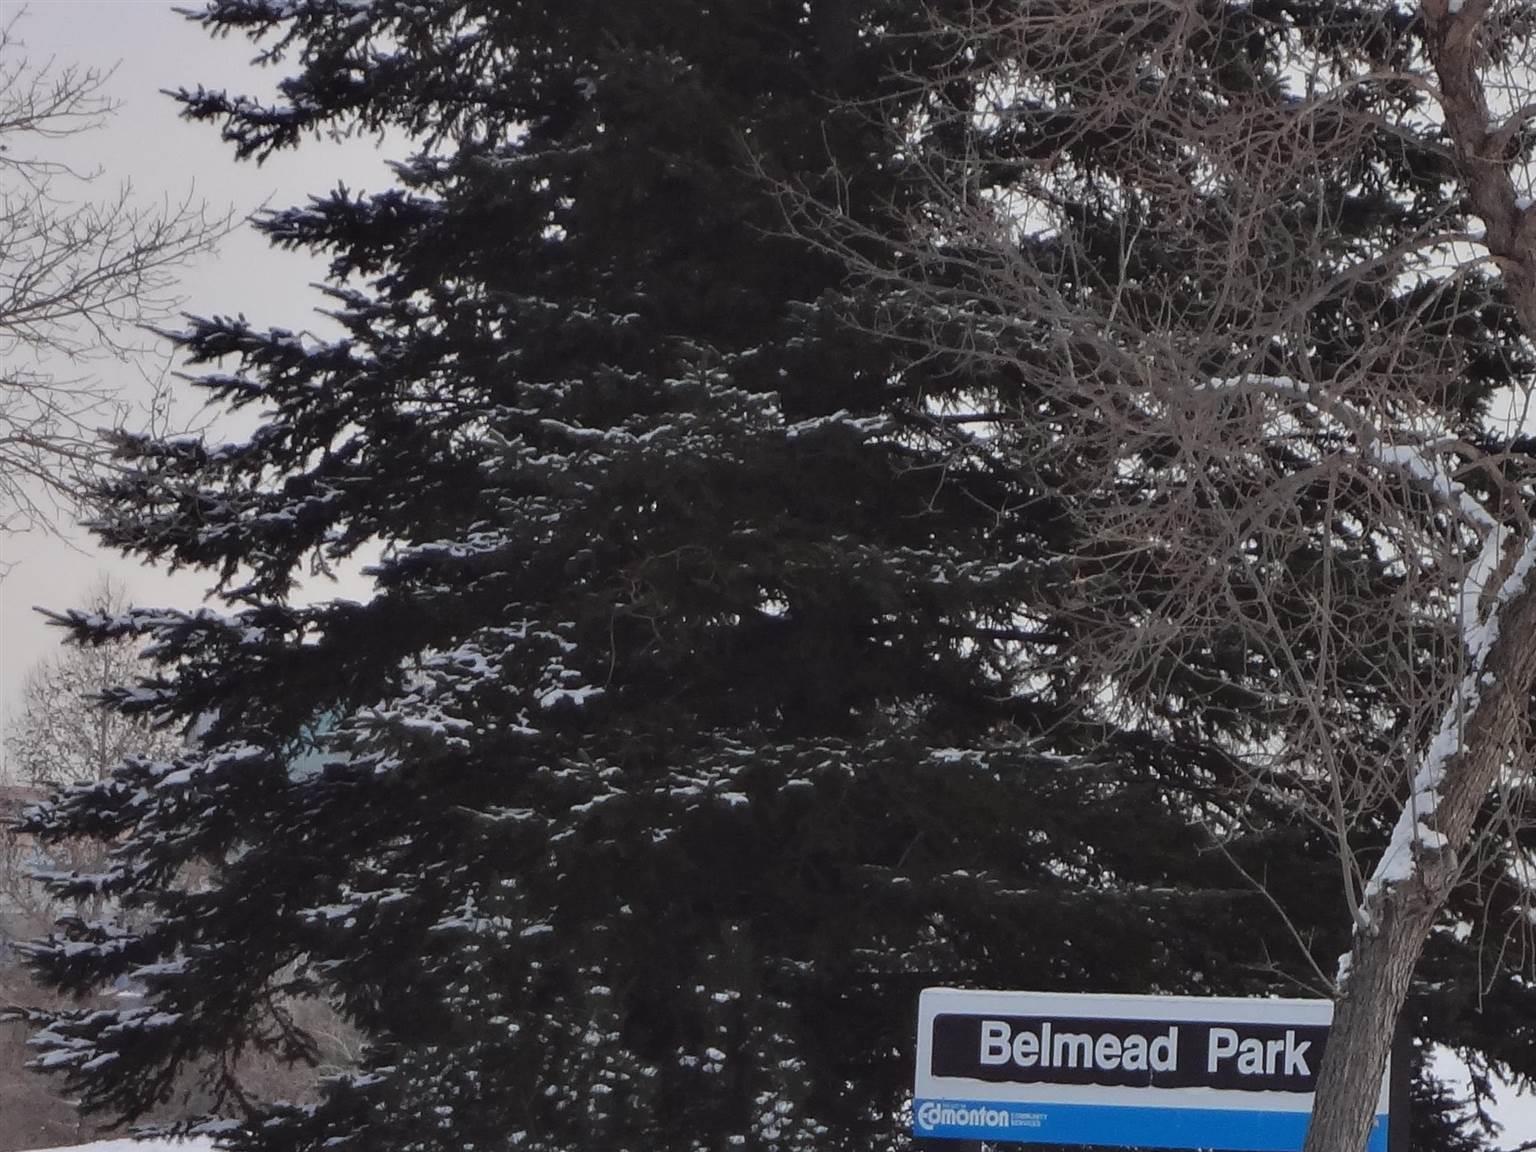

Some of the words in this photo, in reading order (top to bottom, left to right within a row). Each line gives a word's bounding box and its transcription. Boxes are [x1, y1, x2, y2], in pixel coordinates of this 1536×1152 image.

[980, 1020, 1178, 1071] Belmead
[1208, 1029, 1312, 1076] Park
[918, 1102, 1010, 1130] Edmonton
